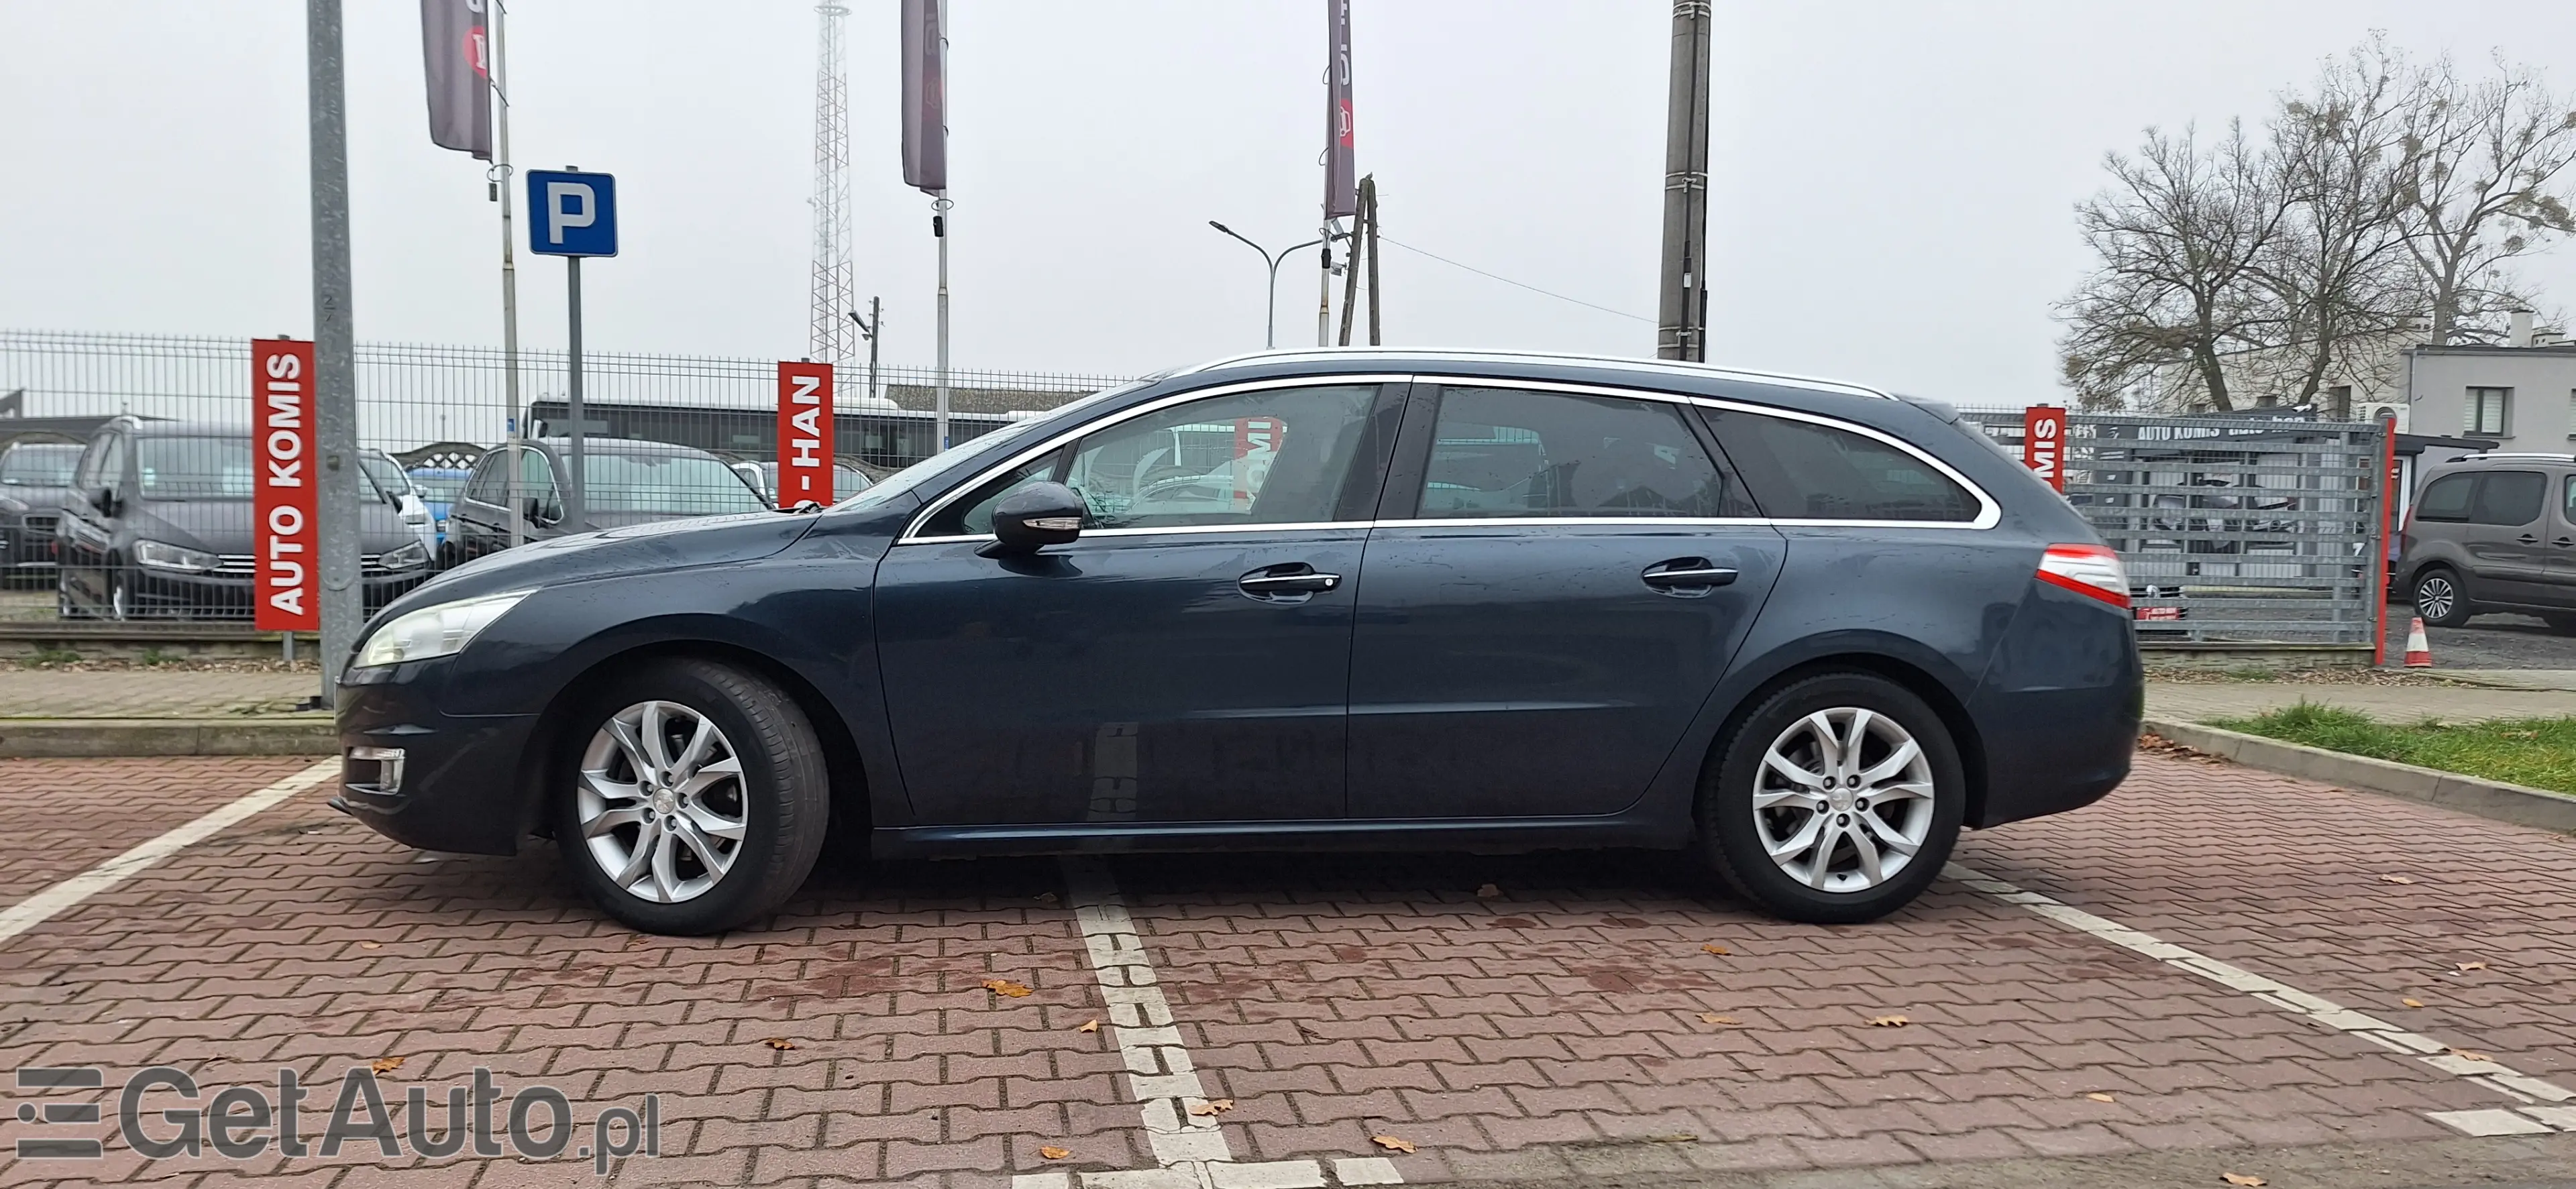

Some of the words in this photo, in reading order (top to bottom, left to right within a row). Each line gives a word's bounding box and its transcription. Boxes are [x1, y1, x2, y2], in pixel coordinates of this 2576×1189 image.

[547, 182, 596, 244] P
[267, 353, 302, 488] KOMIS
[2033, 418, 2057, 484] MIS
[268, 505, 304, 616] AUTO
